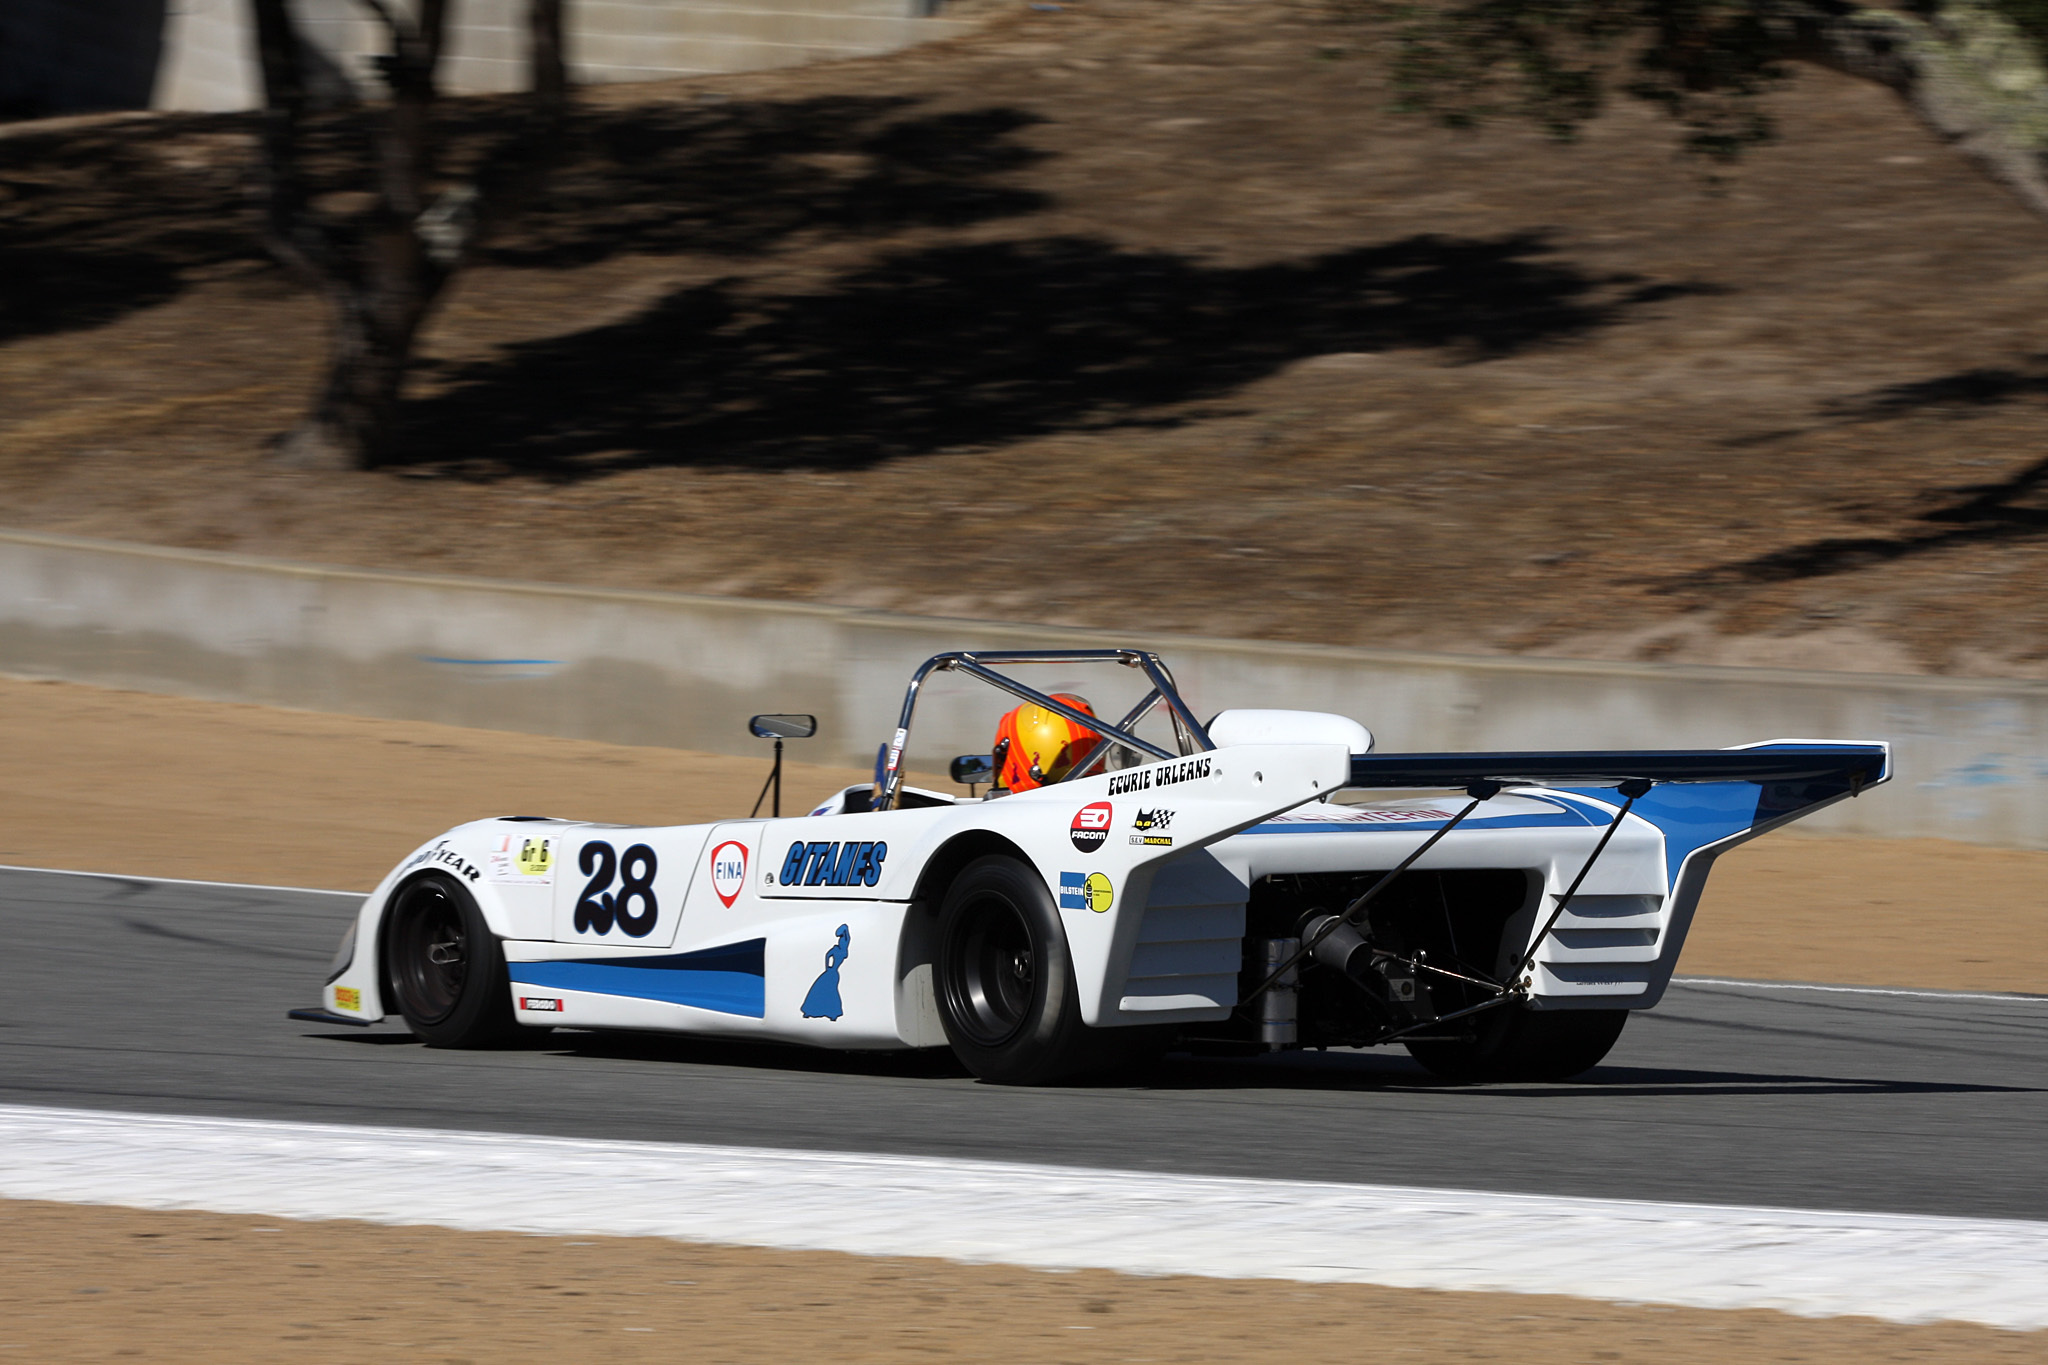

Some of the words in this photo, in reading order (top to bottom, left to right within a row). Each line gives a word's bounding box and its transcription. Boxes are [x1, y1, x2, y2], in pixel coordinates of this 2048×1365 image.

[1108, 769, 1151, 796] ECURIE
[1155, 757, 1211, 787] ORLEANS
[1071, 831, 1106, 840] FACOM
[520, 838, 536, 862] Gr
[540, 839, 550, 863] 6
[716, 861, 743, 879] FINA
[779, 841, 888, 887] GITANES
[573, 839, 659, 938] 28
[1060, 885, 1084, 896] BILSTEIN
